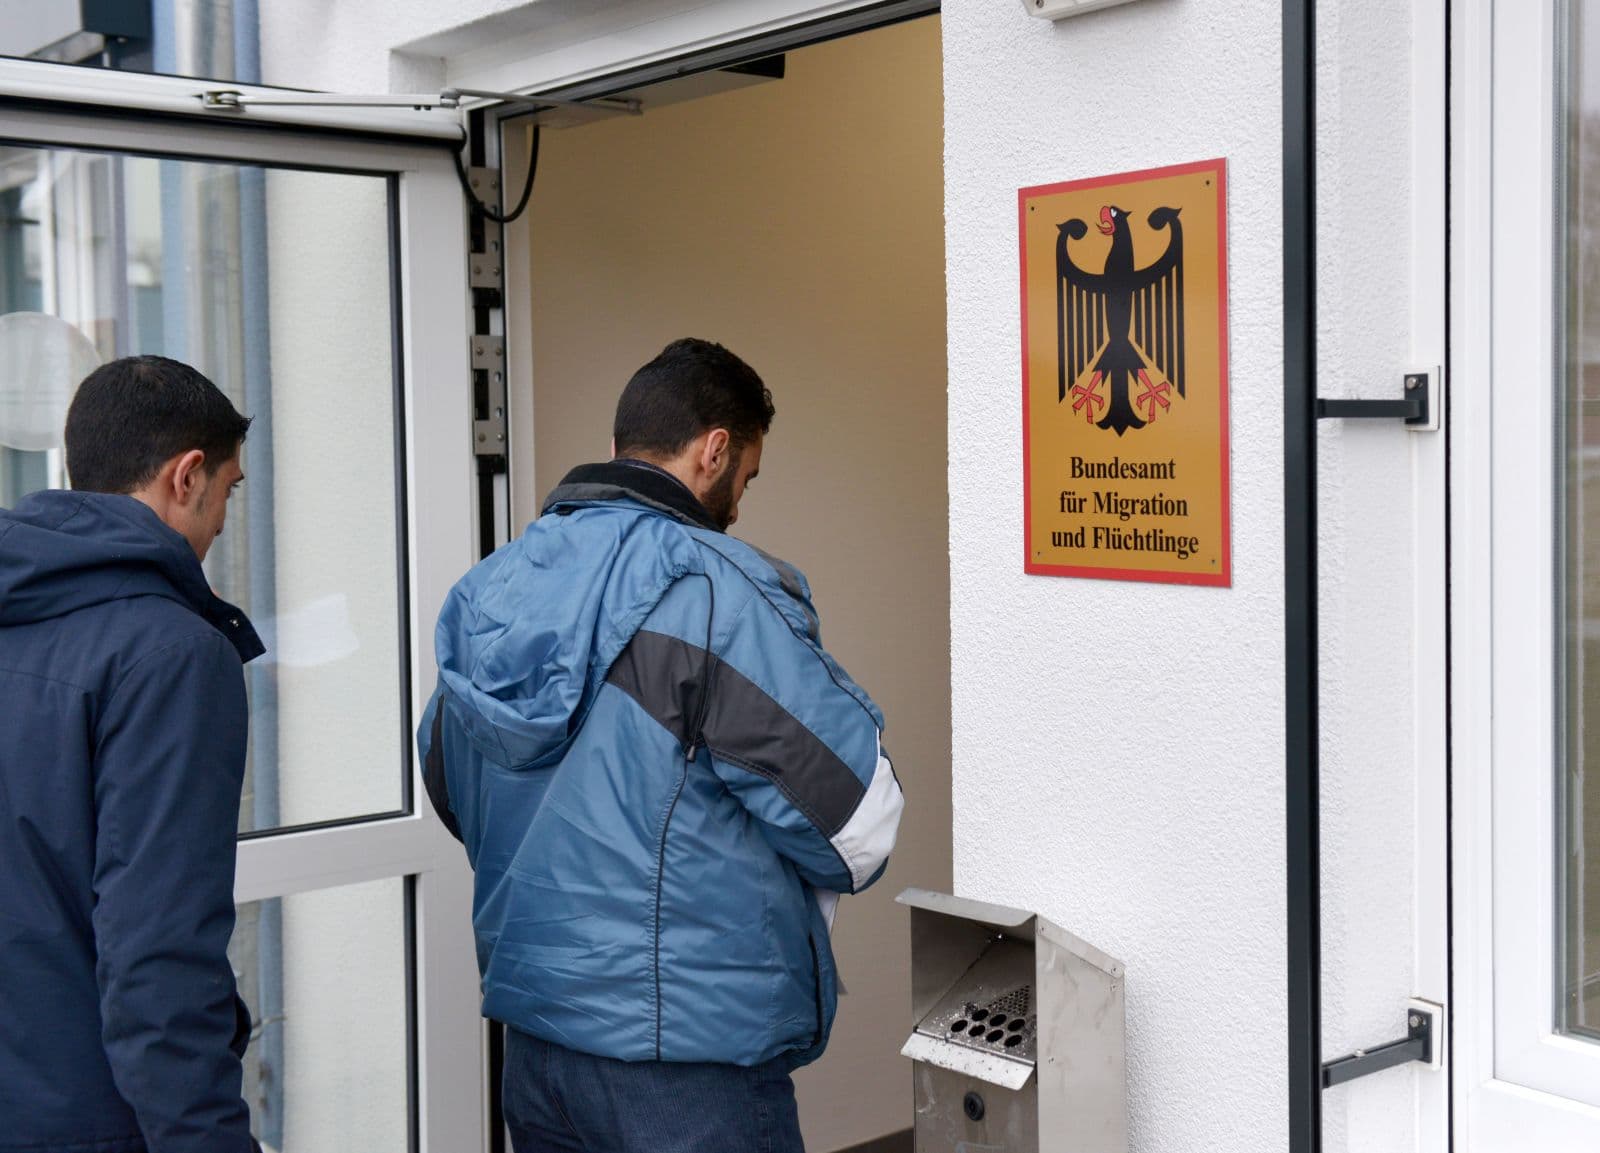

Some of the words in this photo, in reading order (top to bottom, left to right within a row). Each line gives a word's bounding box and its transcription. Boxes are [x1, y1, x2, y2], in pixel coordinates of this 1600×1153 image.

[1070, 456, 1176, 480] Bundesamt
[1060, 490, 1088, 514] für
[1093, 491, 1188, 521] Migration
[1052, 526, 1086, 549] und
[1092, 526, 1199, 559] Flüchtlinge
